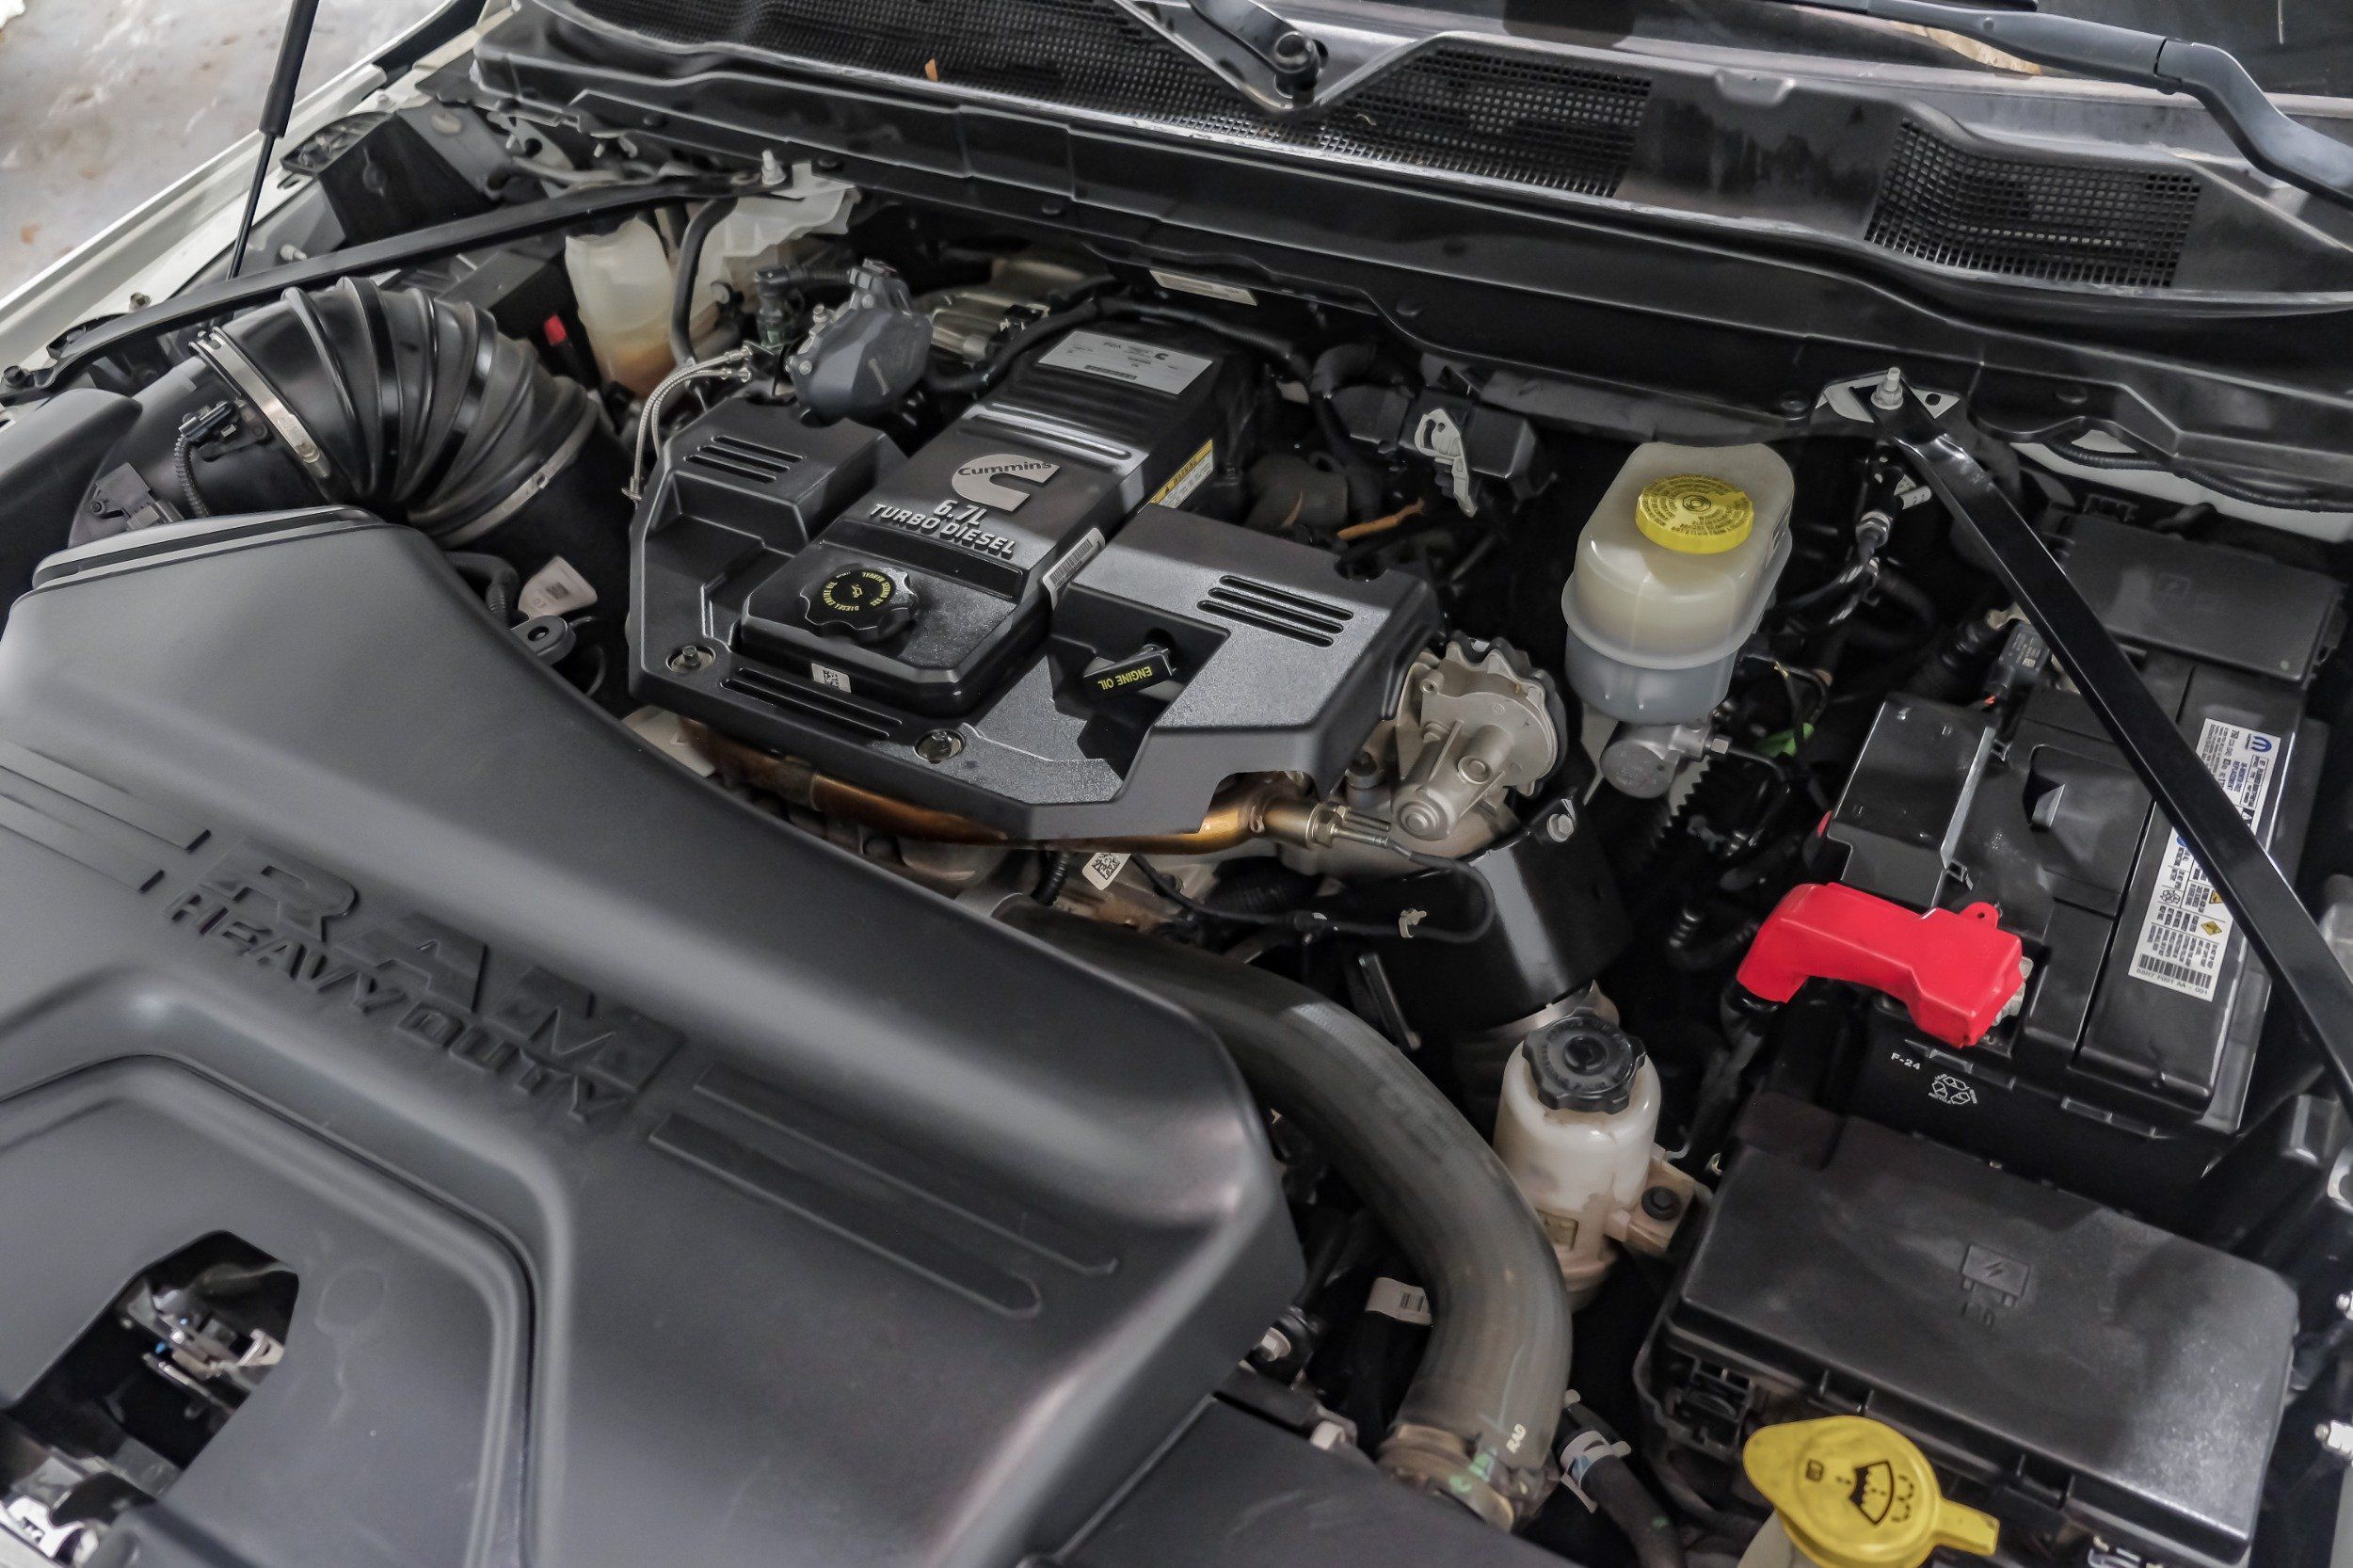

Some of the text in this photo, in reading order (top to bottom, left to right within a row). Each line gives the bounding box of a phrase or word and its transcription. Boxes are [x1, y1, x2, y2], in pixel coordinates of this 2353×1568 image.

[957, 461, 1052, 476] Cummins
[933, 499, 987, 526] 6.7L
[870, 504, 1016, 557] TURBO DIESEL
[834, 603, 860, 612] DIESEL
[1097, 665, 1153, 691] ENGINE OIL
[199, 837, 686, 1093] RAM
[168, 891, 633, 1122] HEAVY DUTY
[1891, 1052, 1921, 1070] F-24
